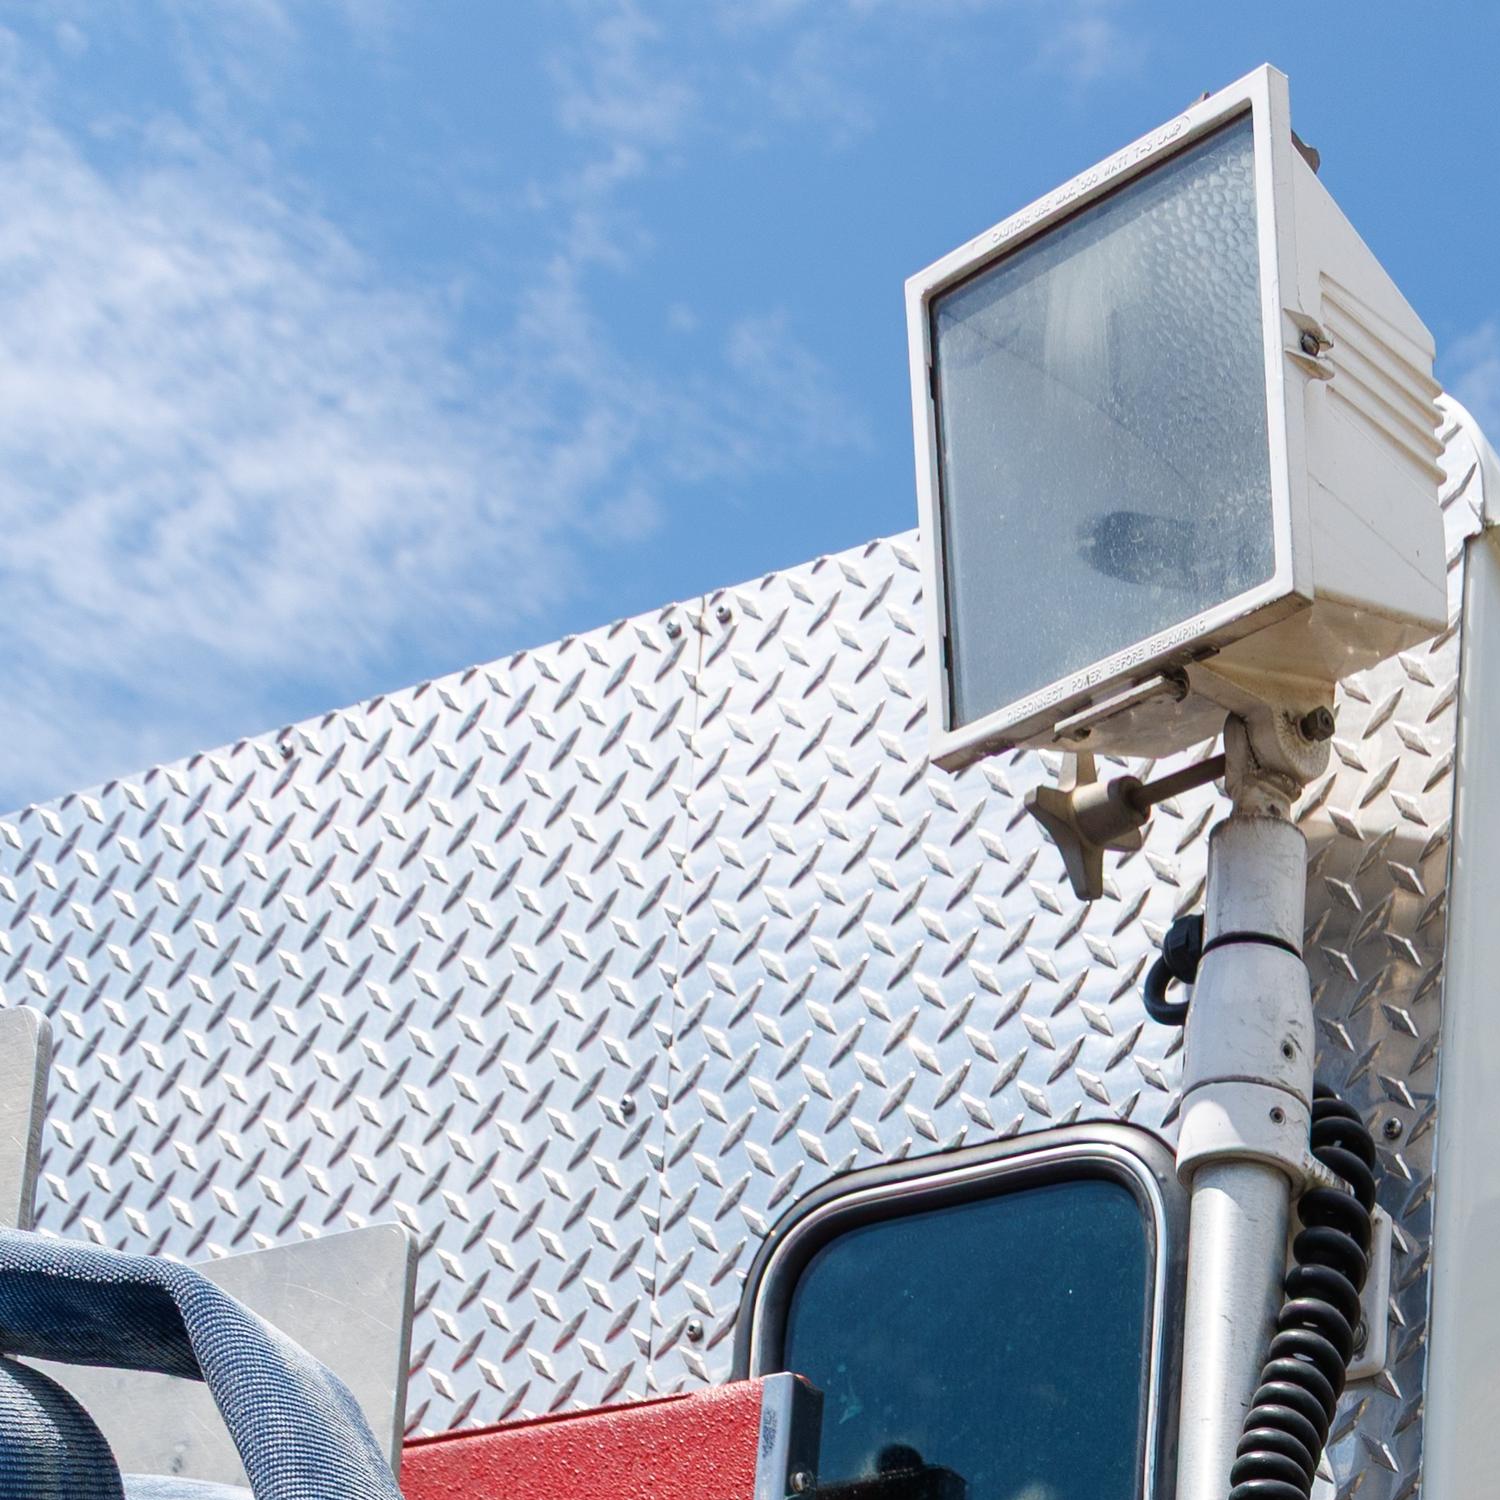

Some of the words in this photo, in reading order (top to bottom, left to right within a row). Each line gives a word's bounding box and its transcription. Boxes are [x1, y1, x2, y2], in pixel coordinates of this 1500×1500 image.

[1104, 153, 1129, 178] WATT
[1006, 687, 1065, 724] DISCONNECT
[1071, 669, 1103, 693] POWER
[1108, 649, 1145, 674] BEFORE
[1150, 620, 1208, 655] RELAMPING
